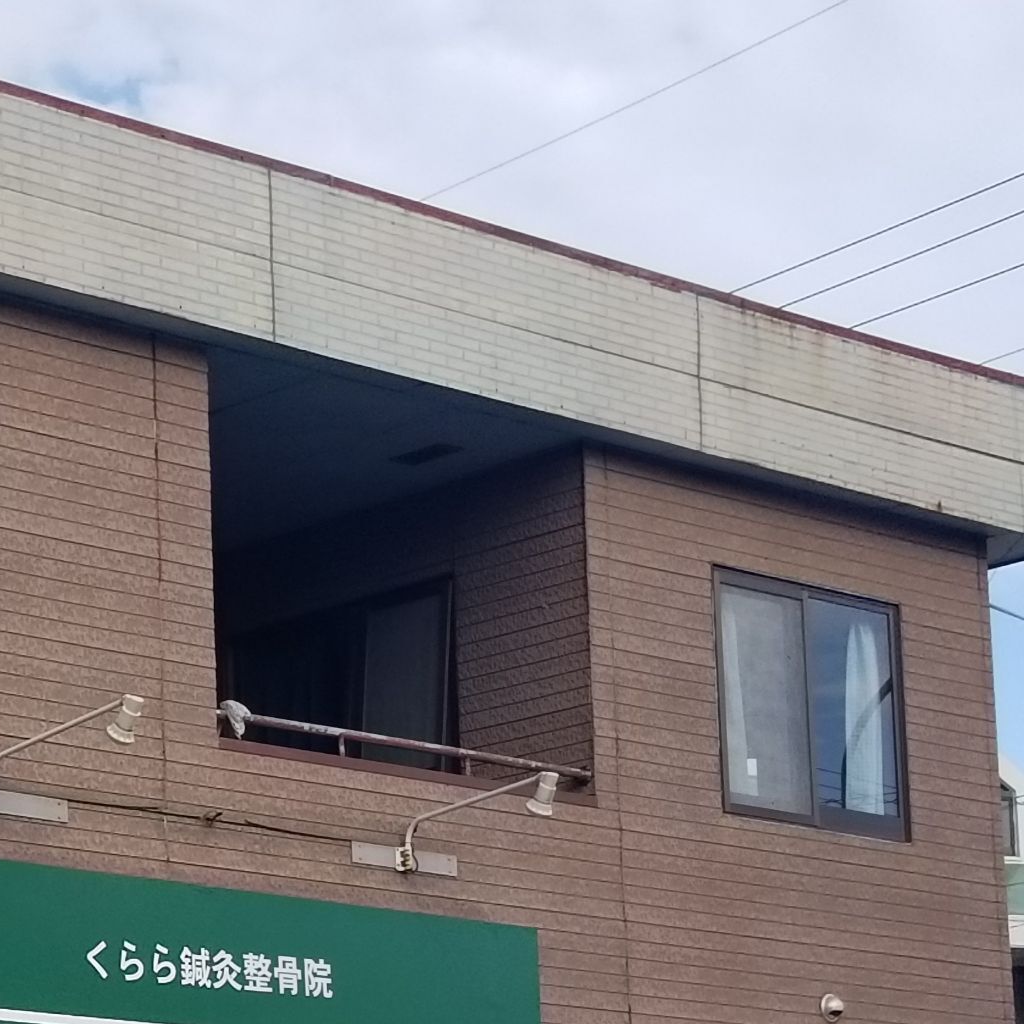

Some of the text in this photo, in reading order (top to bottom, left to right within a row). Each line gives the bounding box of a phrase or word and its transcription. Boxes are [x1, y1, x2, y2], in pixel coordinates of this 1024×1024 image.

[86, 940, 334, 998] くらら鍼灸整骨院
